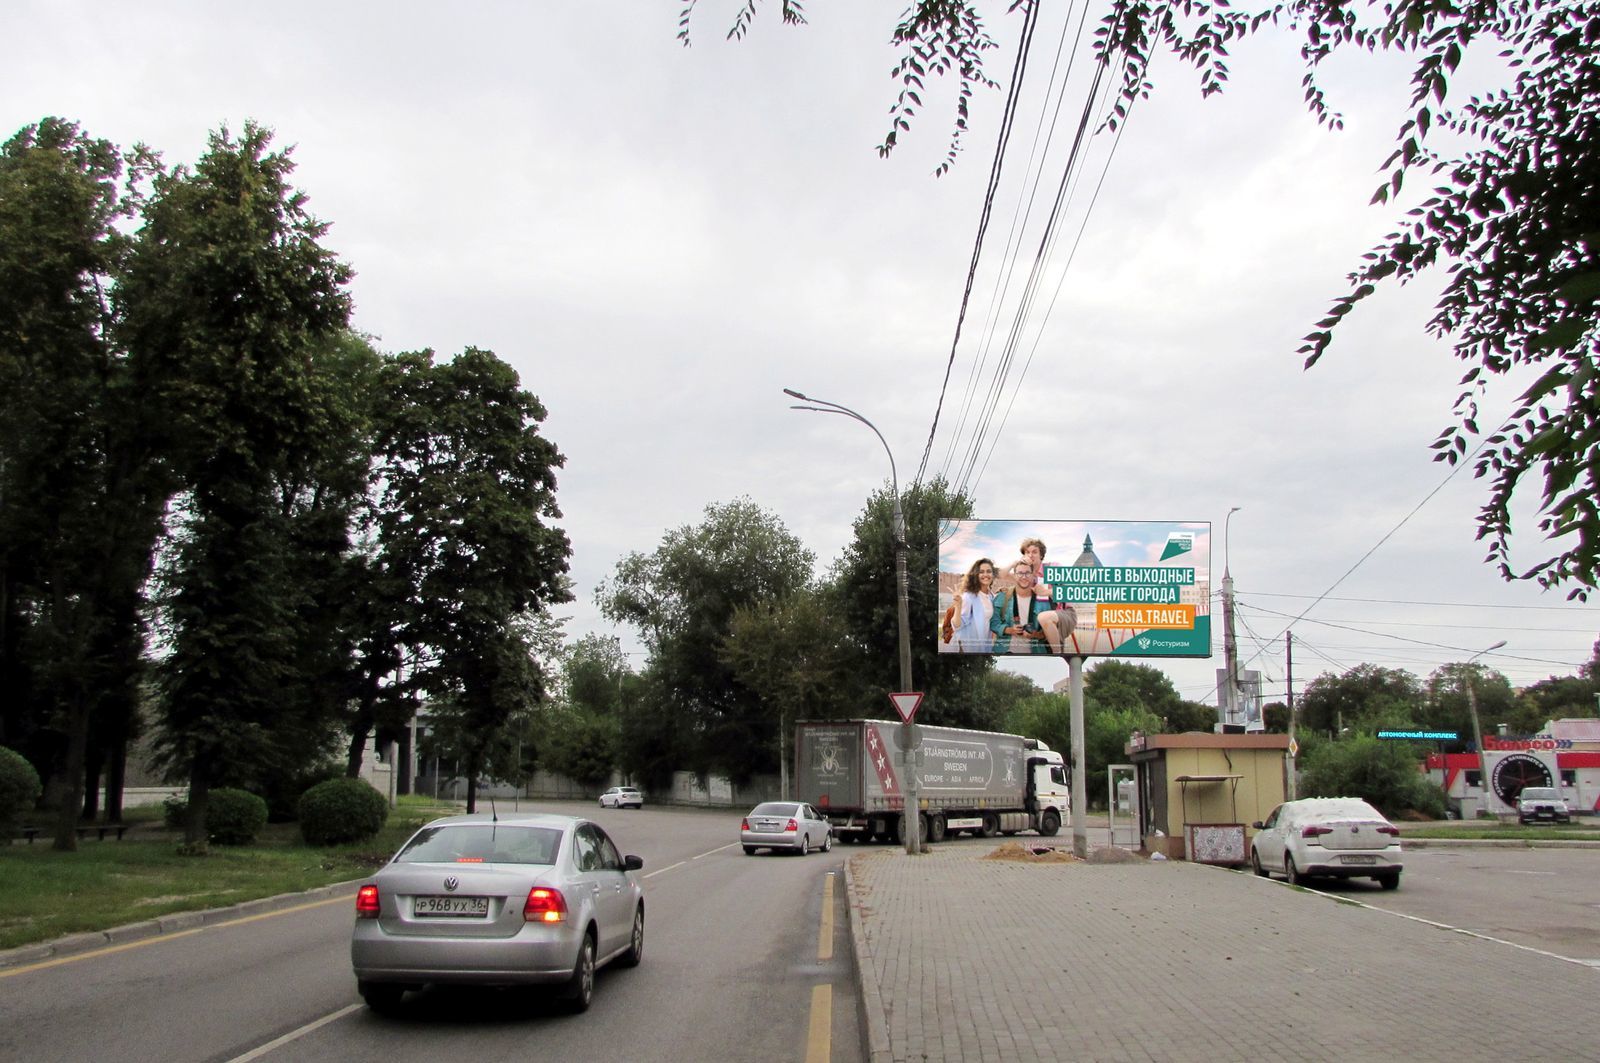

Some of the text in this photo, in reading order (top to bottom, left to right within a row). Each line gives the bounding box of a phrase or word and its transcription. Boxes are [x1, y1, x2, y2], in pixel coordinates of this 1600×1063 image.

[1047, 567, 1193, 585] ВЫХОДИТЕ В ВЫХОДНЫЕ
[1056, 586, 1176, 603] В СОСЕДНИЕ ГОРОДА
[1102, 609, 1189, 625] RUSSIA.TRAVEL
[1152, 640, 1190, 649] Ростуризм
[943, 762, 967, 772] SWEDEN
